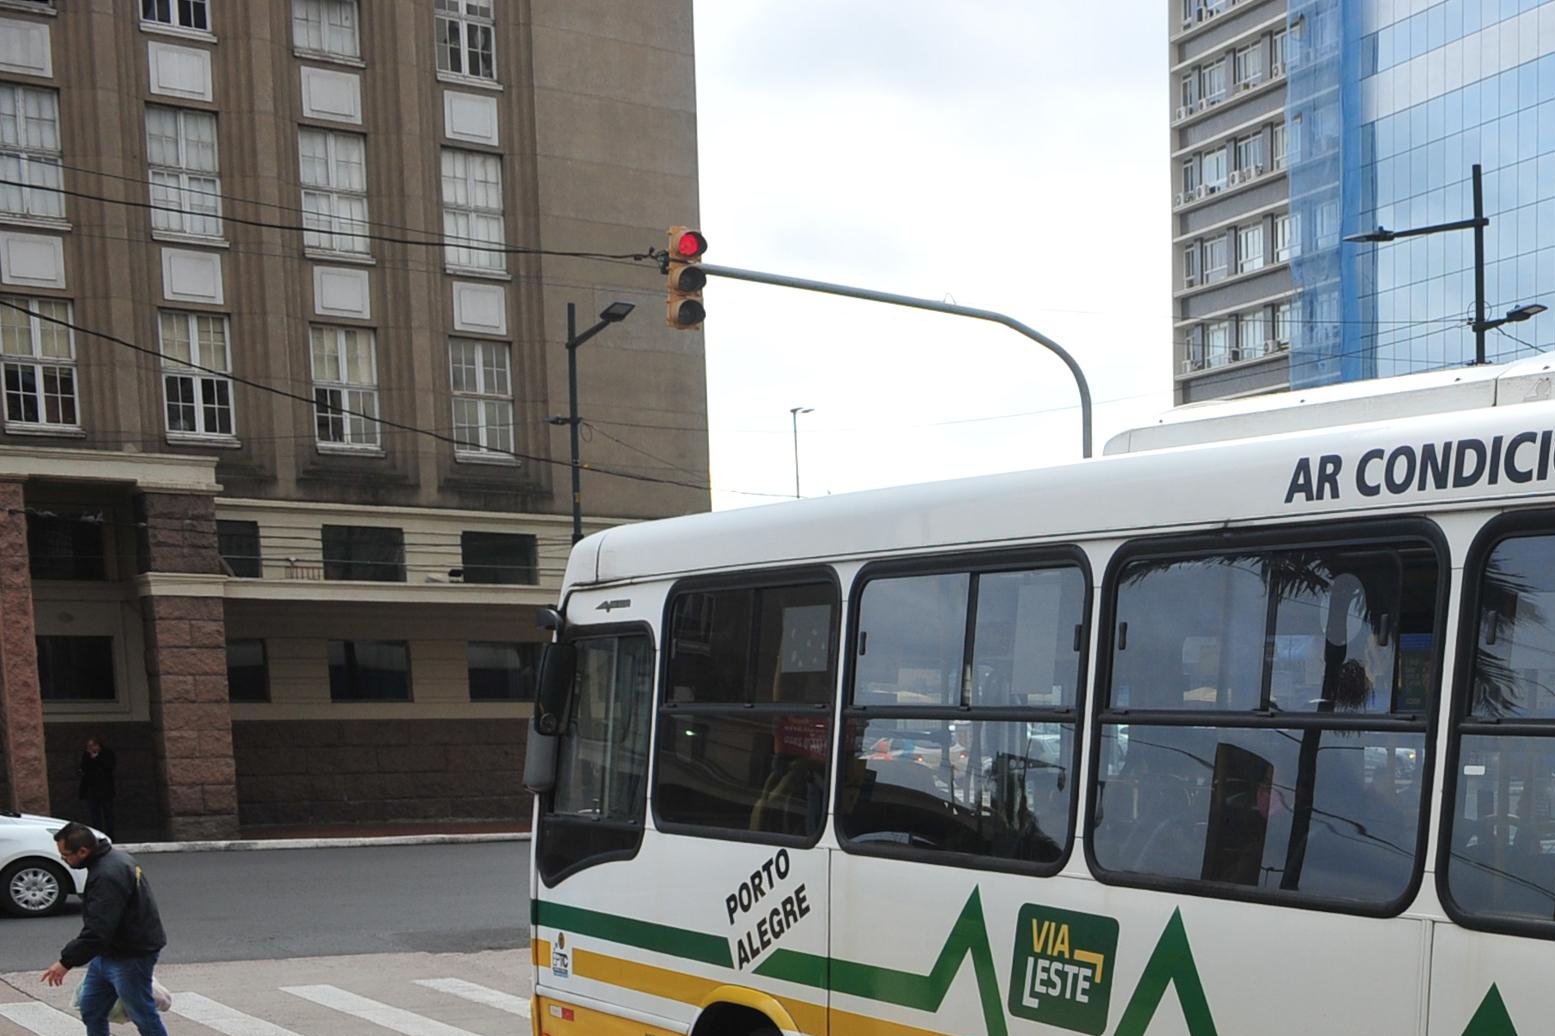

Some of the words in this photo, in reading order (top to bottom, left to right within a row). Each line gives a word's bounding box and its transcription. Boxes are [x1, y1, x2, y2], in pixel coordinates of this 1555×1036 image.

[1284, 456, 1342, 505] AR
[725, 848, 790, 926] PORTO
[736, 883, 811, 971] ALEGRE
[1031, 918, 1070, 959] VIA
[1022, 956, 1093, 1009] LESTE
